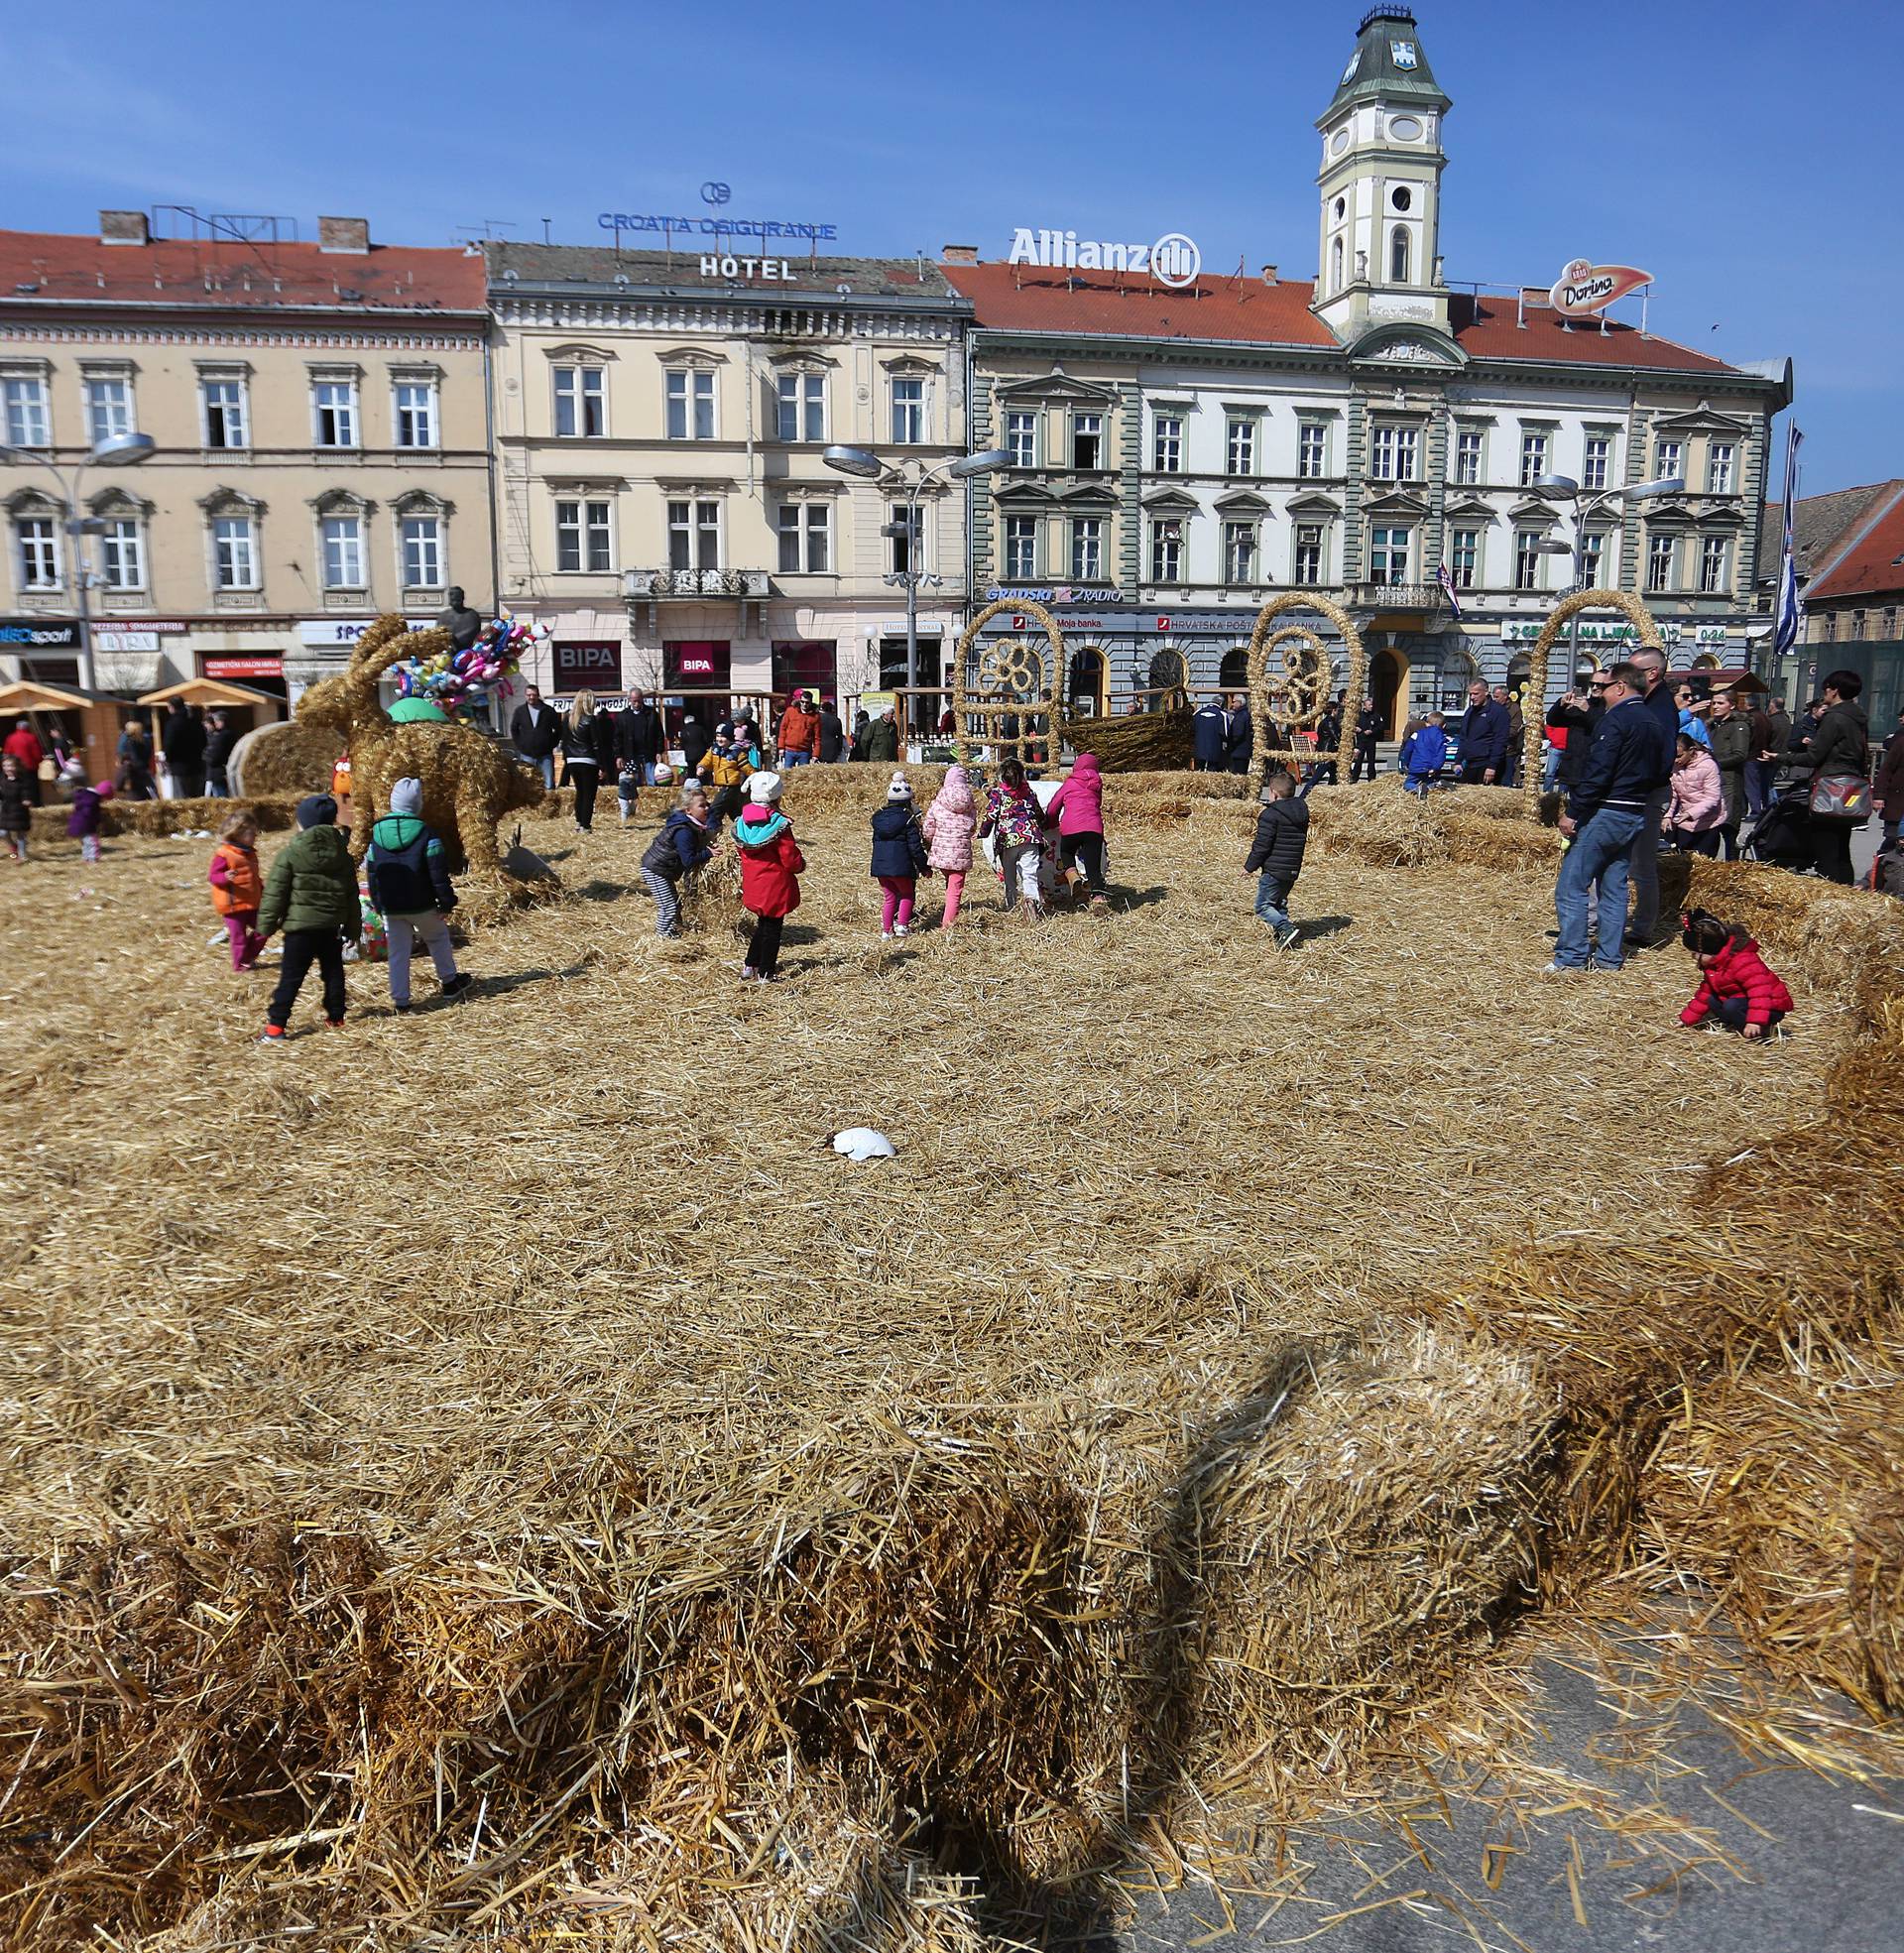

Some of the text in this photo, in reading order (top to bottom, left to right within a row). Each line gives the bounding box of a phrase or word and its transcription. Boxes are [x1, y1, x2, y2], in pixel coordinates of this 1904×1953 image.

[597, 212, 838, 241] CROATIA OSIGURANJE
[1009, 227, 1150, 273] Allianz
[700, 255, 797, 281] HOTEL
[1563, 277, 1612, 307] Dorina
[987, 587, 1052, 601] GRADSKI
[1057, 619, 1076, 629] Moja
[1170, 620, 1223, 631] HRVATSKA
[1701, 629, 1726, 642] 0-24
[559, 648, 616, 668] BIPA
[683, 660, 711, 671] BIPA
